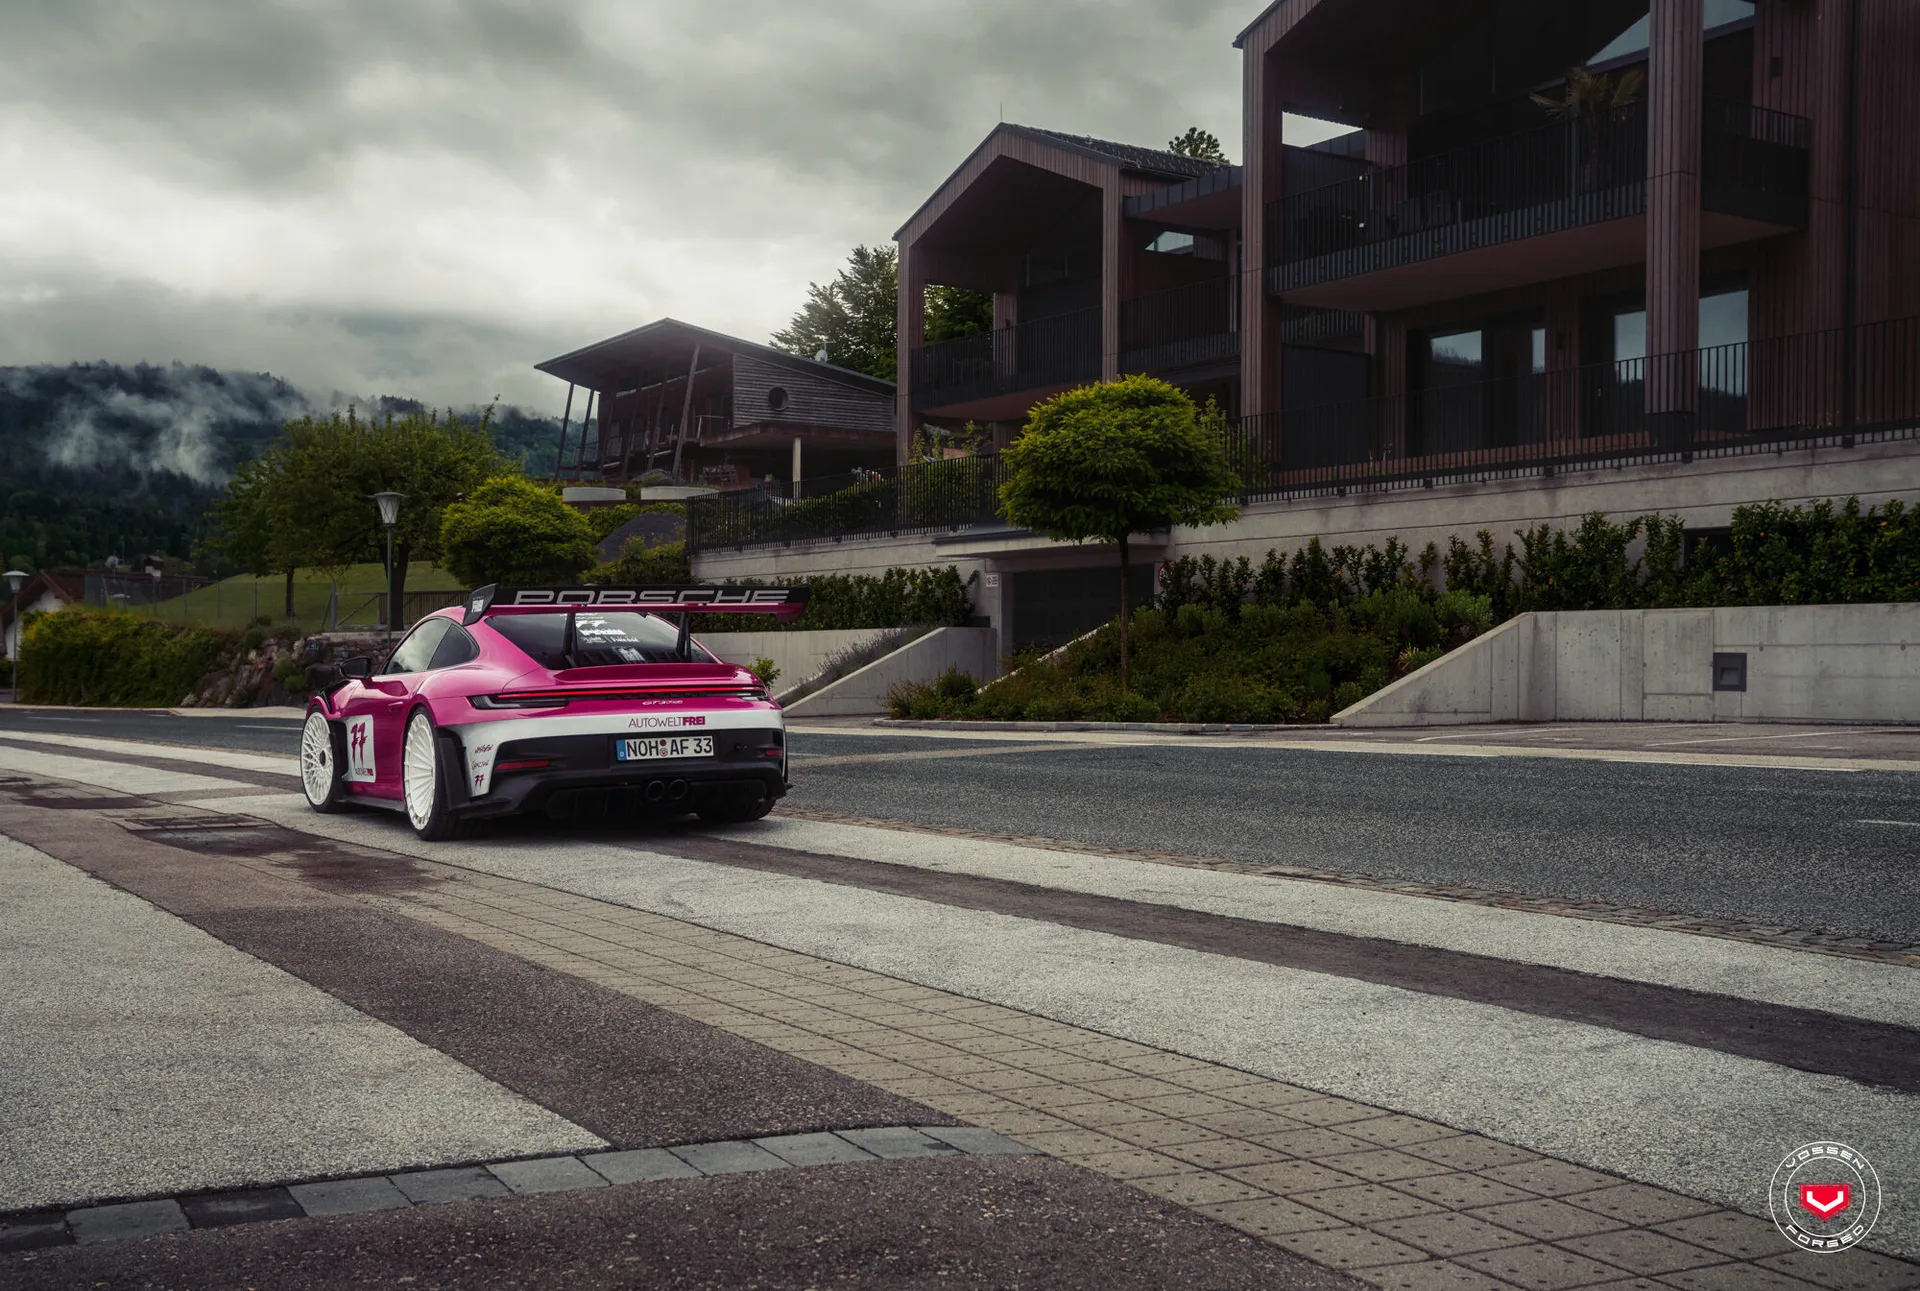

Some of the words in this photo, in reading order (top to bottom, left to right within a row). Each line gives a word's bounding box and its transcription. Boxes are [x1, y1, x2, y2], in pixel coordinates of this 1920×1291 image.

[513, 589, 791, 605] PORSCHE
[628, 716, 706, 728] AUTOWELTFREI
[626, 740, 660, 758] NOH
[670, 739, 690, 755] AF
[693, 737, 712, 754] 33
